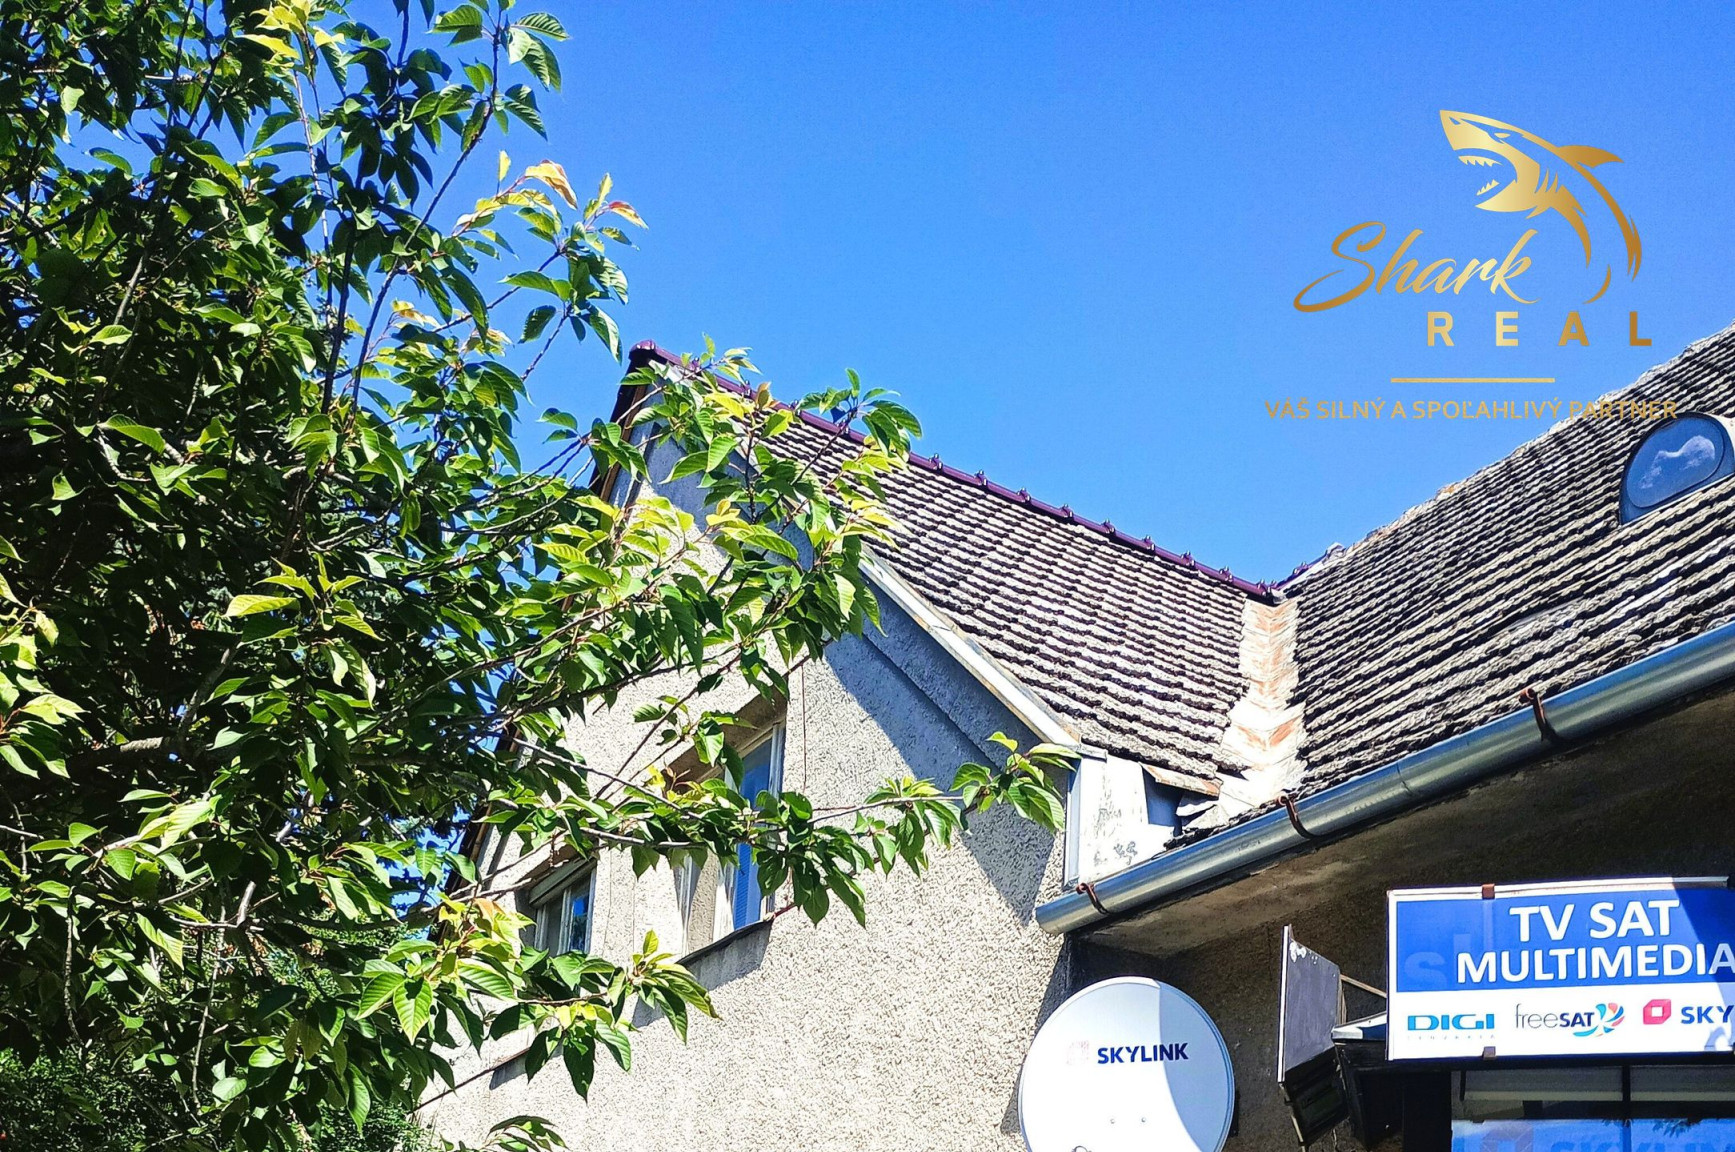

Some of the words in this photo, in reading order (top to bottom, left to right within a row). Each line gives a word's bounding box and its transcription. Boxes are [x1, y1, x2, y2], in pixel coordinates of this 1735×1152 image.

[1509, 903, 1576, 943] TV
[1588, 899, 1681, 939] SAT
[1456, 942, 1735, 984] MULTIMEDIA
[1407, 1013, 1495, 1030] DIGI
[1680, 1004, 1735, 1025] SKY
[1097, 1042, 1189, 1064] SKYLINK
